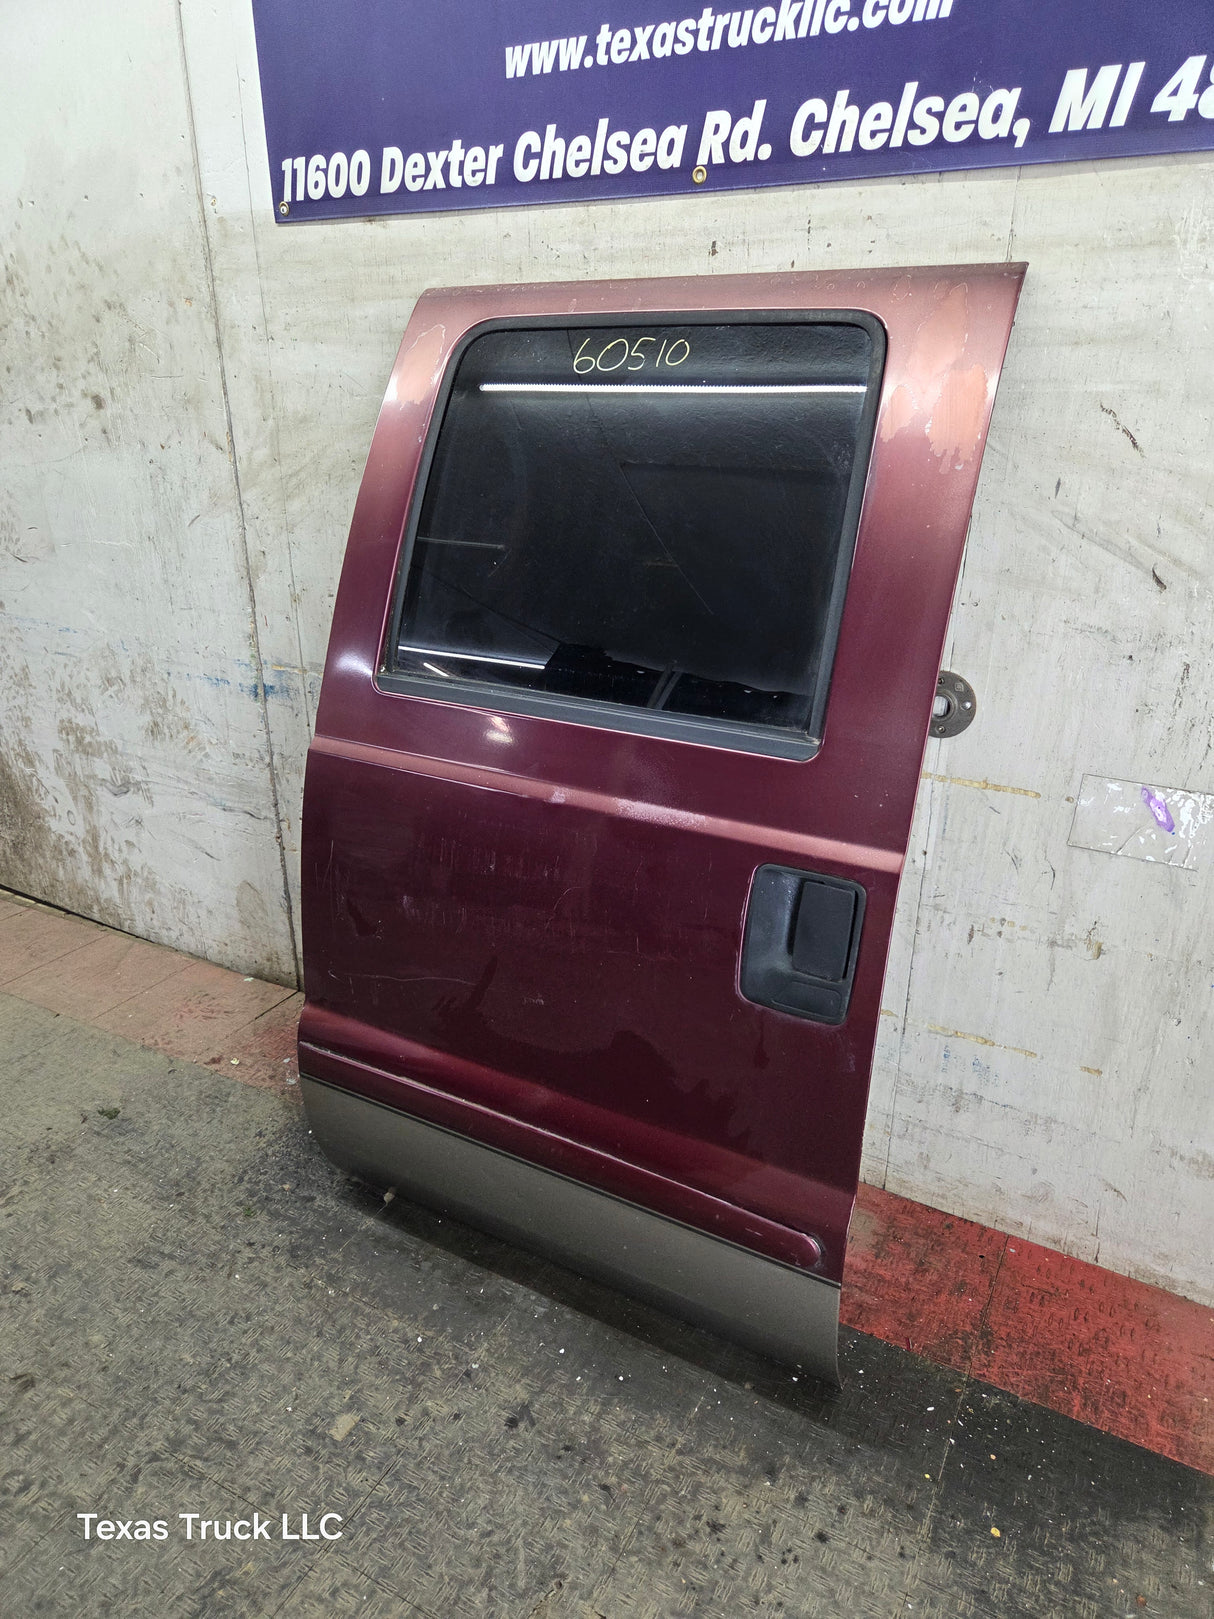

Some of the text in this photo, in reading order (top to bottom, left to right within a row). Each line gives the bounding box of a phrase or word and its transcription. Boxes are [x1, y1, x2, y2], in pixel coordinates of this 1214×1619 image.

[281, 149, 371, 201] 11600
[380, 139, 504, 194] Dexter
[513, 118, 688, 183] Chelsea
[697, 99, 772, 166] Rd.
[789, 82, 1031, 156] Chelsea,
[1048, 61, 1146, 134] MI
[573, 337, 690, 374] 60510
